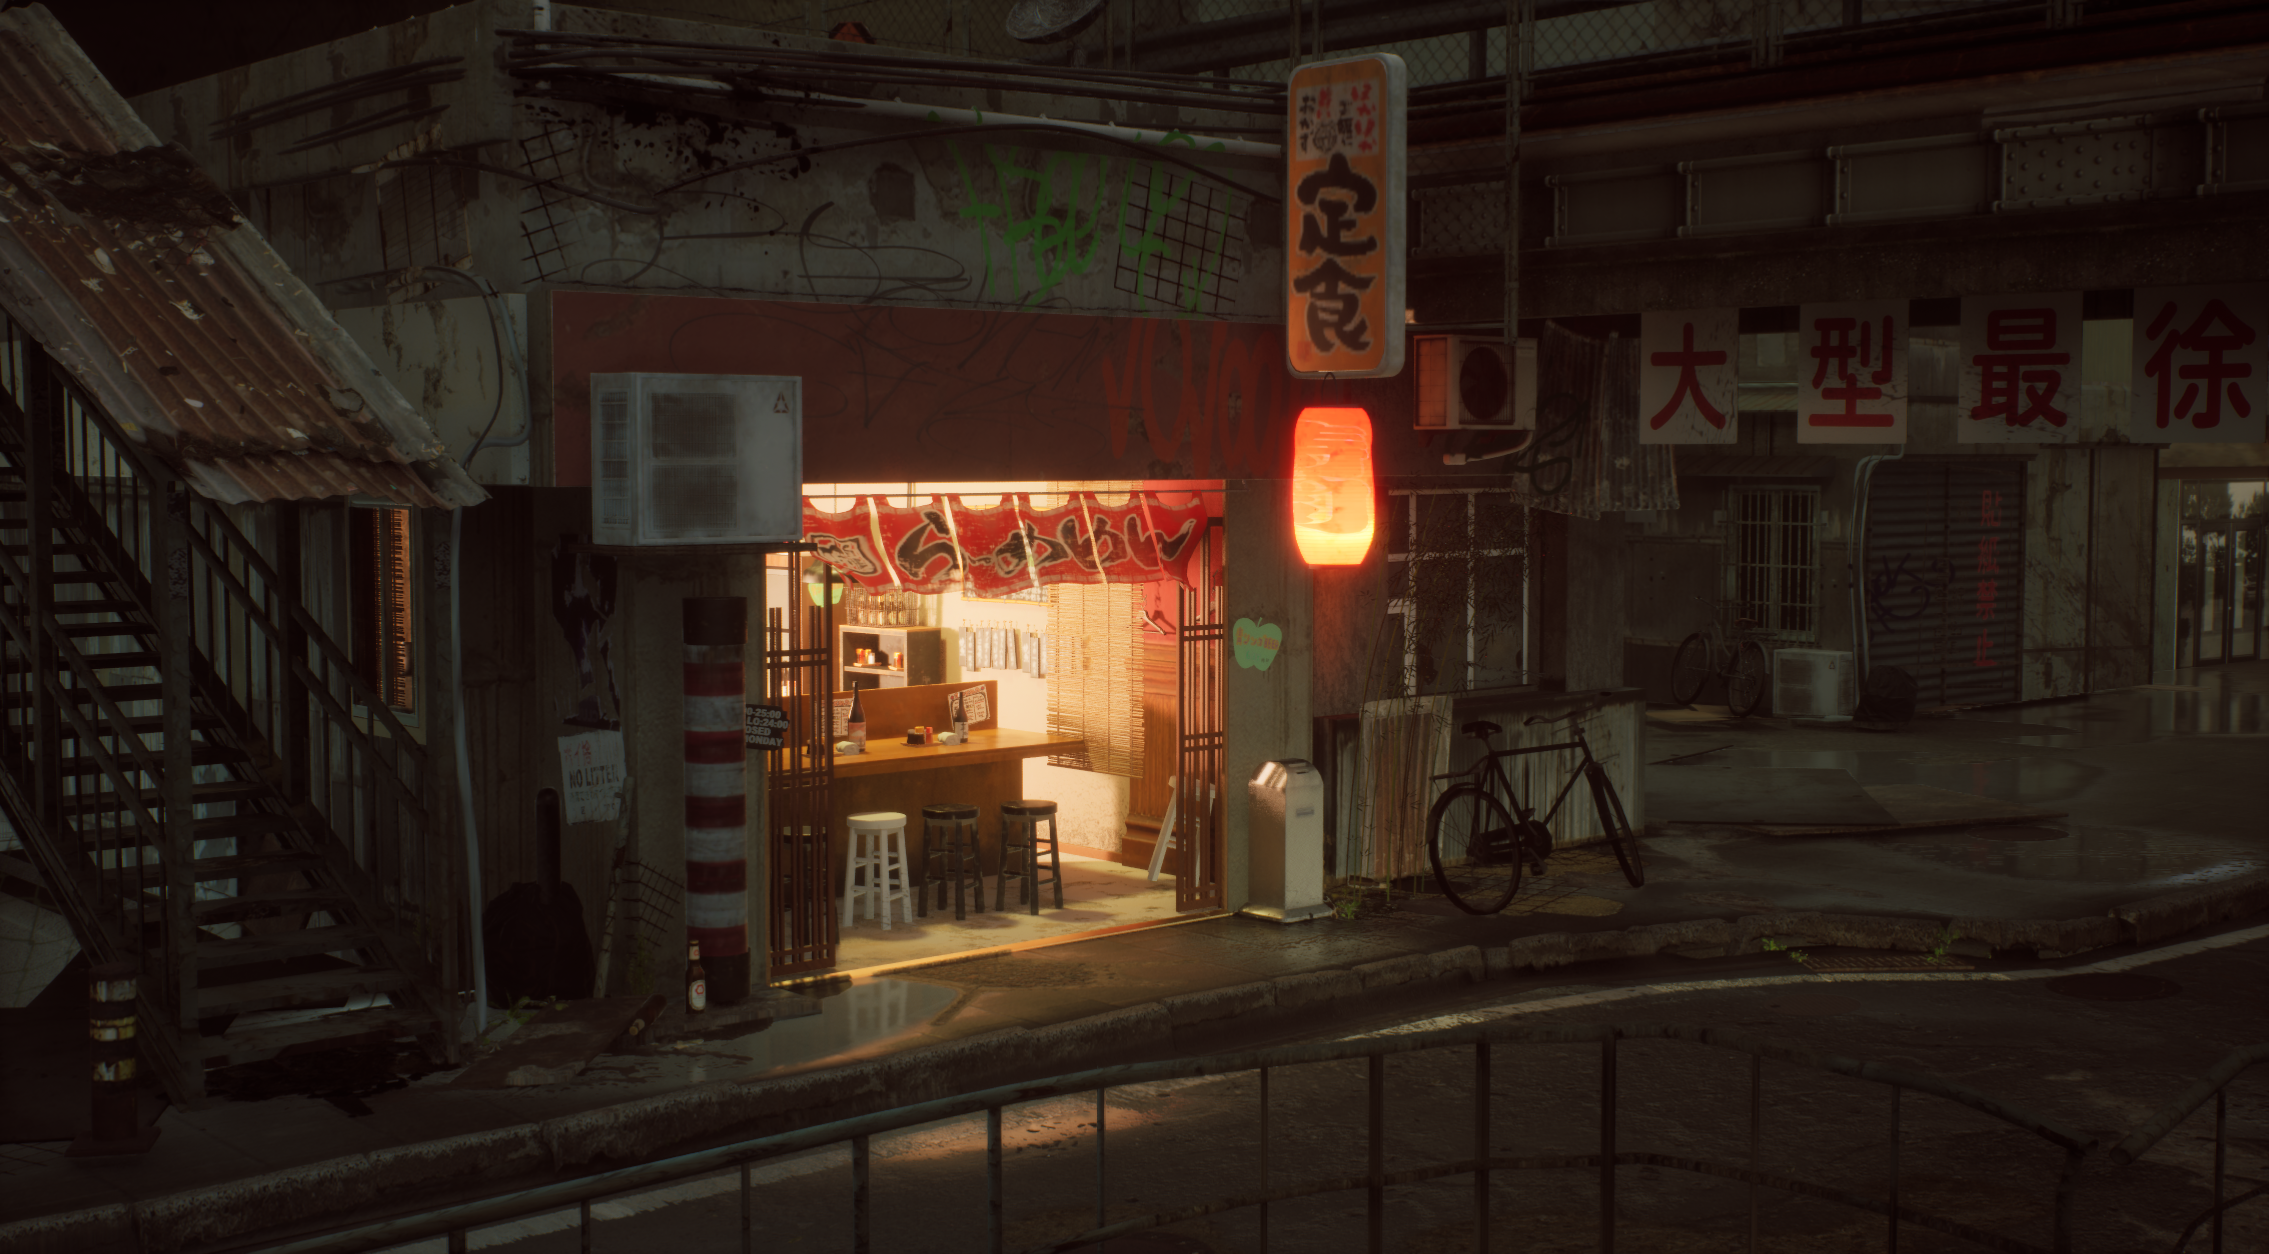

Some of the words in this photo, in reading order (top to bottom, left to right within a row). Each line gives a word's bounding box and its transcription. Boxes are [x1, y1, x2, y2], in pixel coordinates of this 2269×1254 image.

[1294, 153, 1378, 353] 定食
[1973, 490, 2003, 667] 貼紙禁止
[746, 707, 782, 719] 0-25:00
[569, 768, 583, 789] NO
